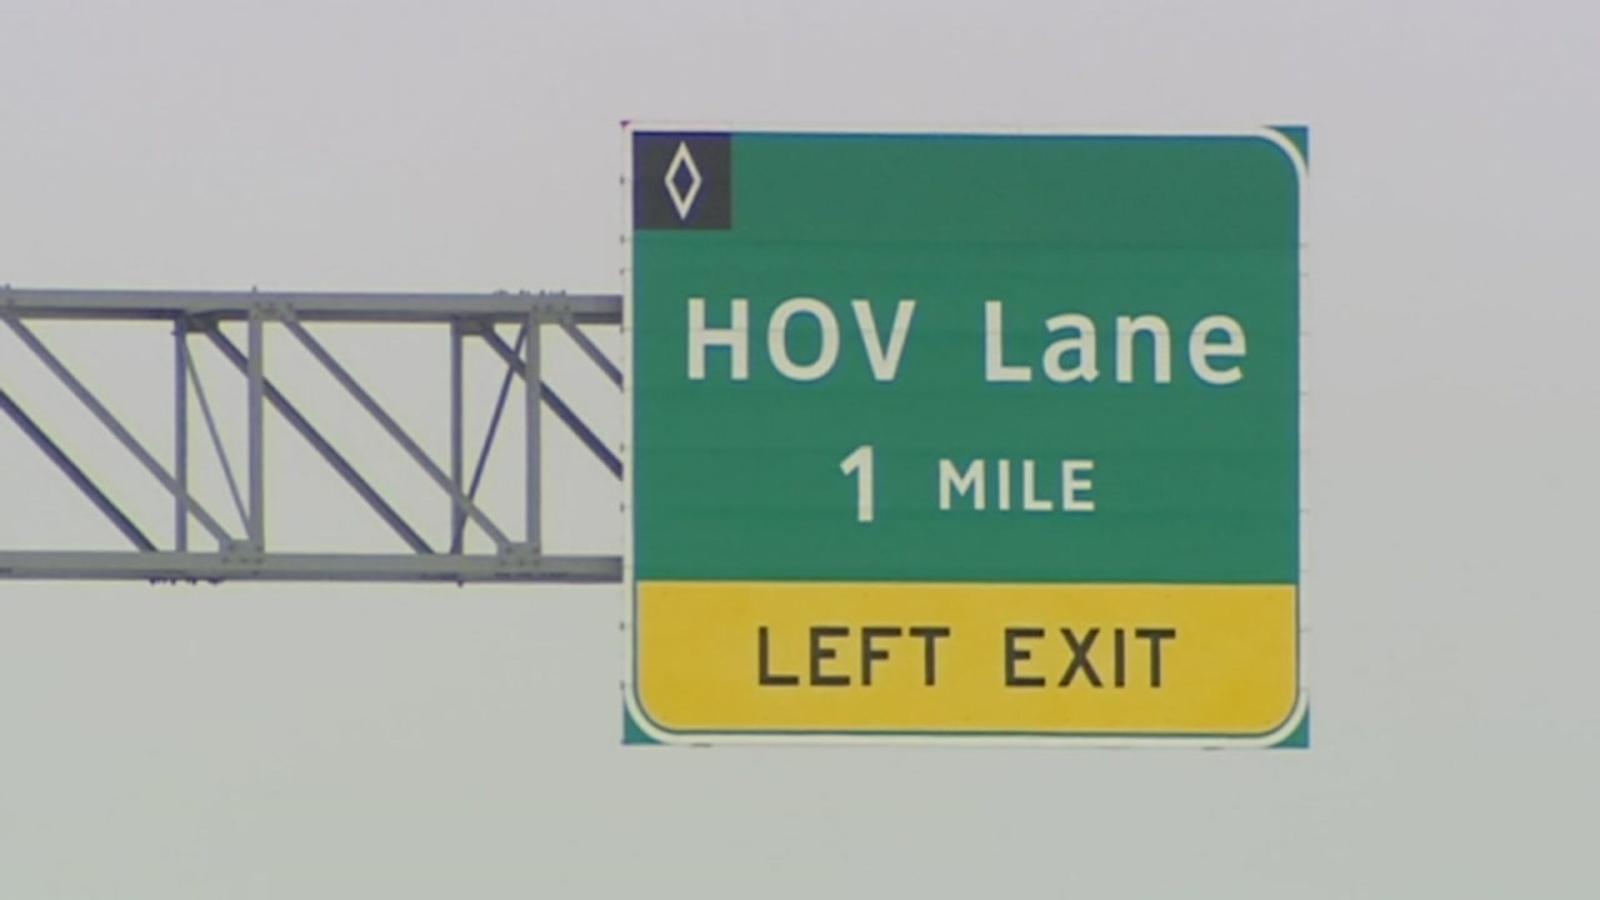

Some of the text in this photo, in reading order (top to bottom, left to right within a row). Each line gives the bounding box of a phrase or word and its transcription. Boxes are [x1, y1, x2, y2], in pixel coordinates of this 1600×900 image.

[687, 297, 1247, 384] HOV Lane
[839, 445, 1096, 522] 1 MILE
[757, 626, 1177, 688] LEFT EXIT
